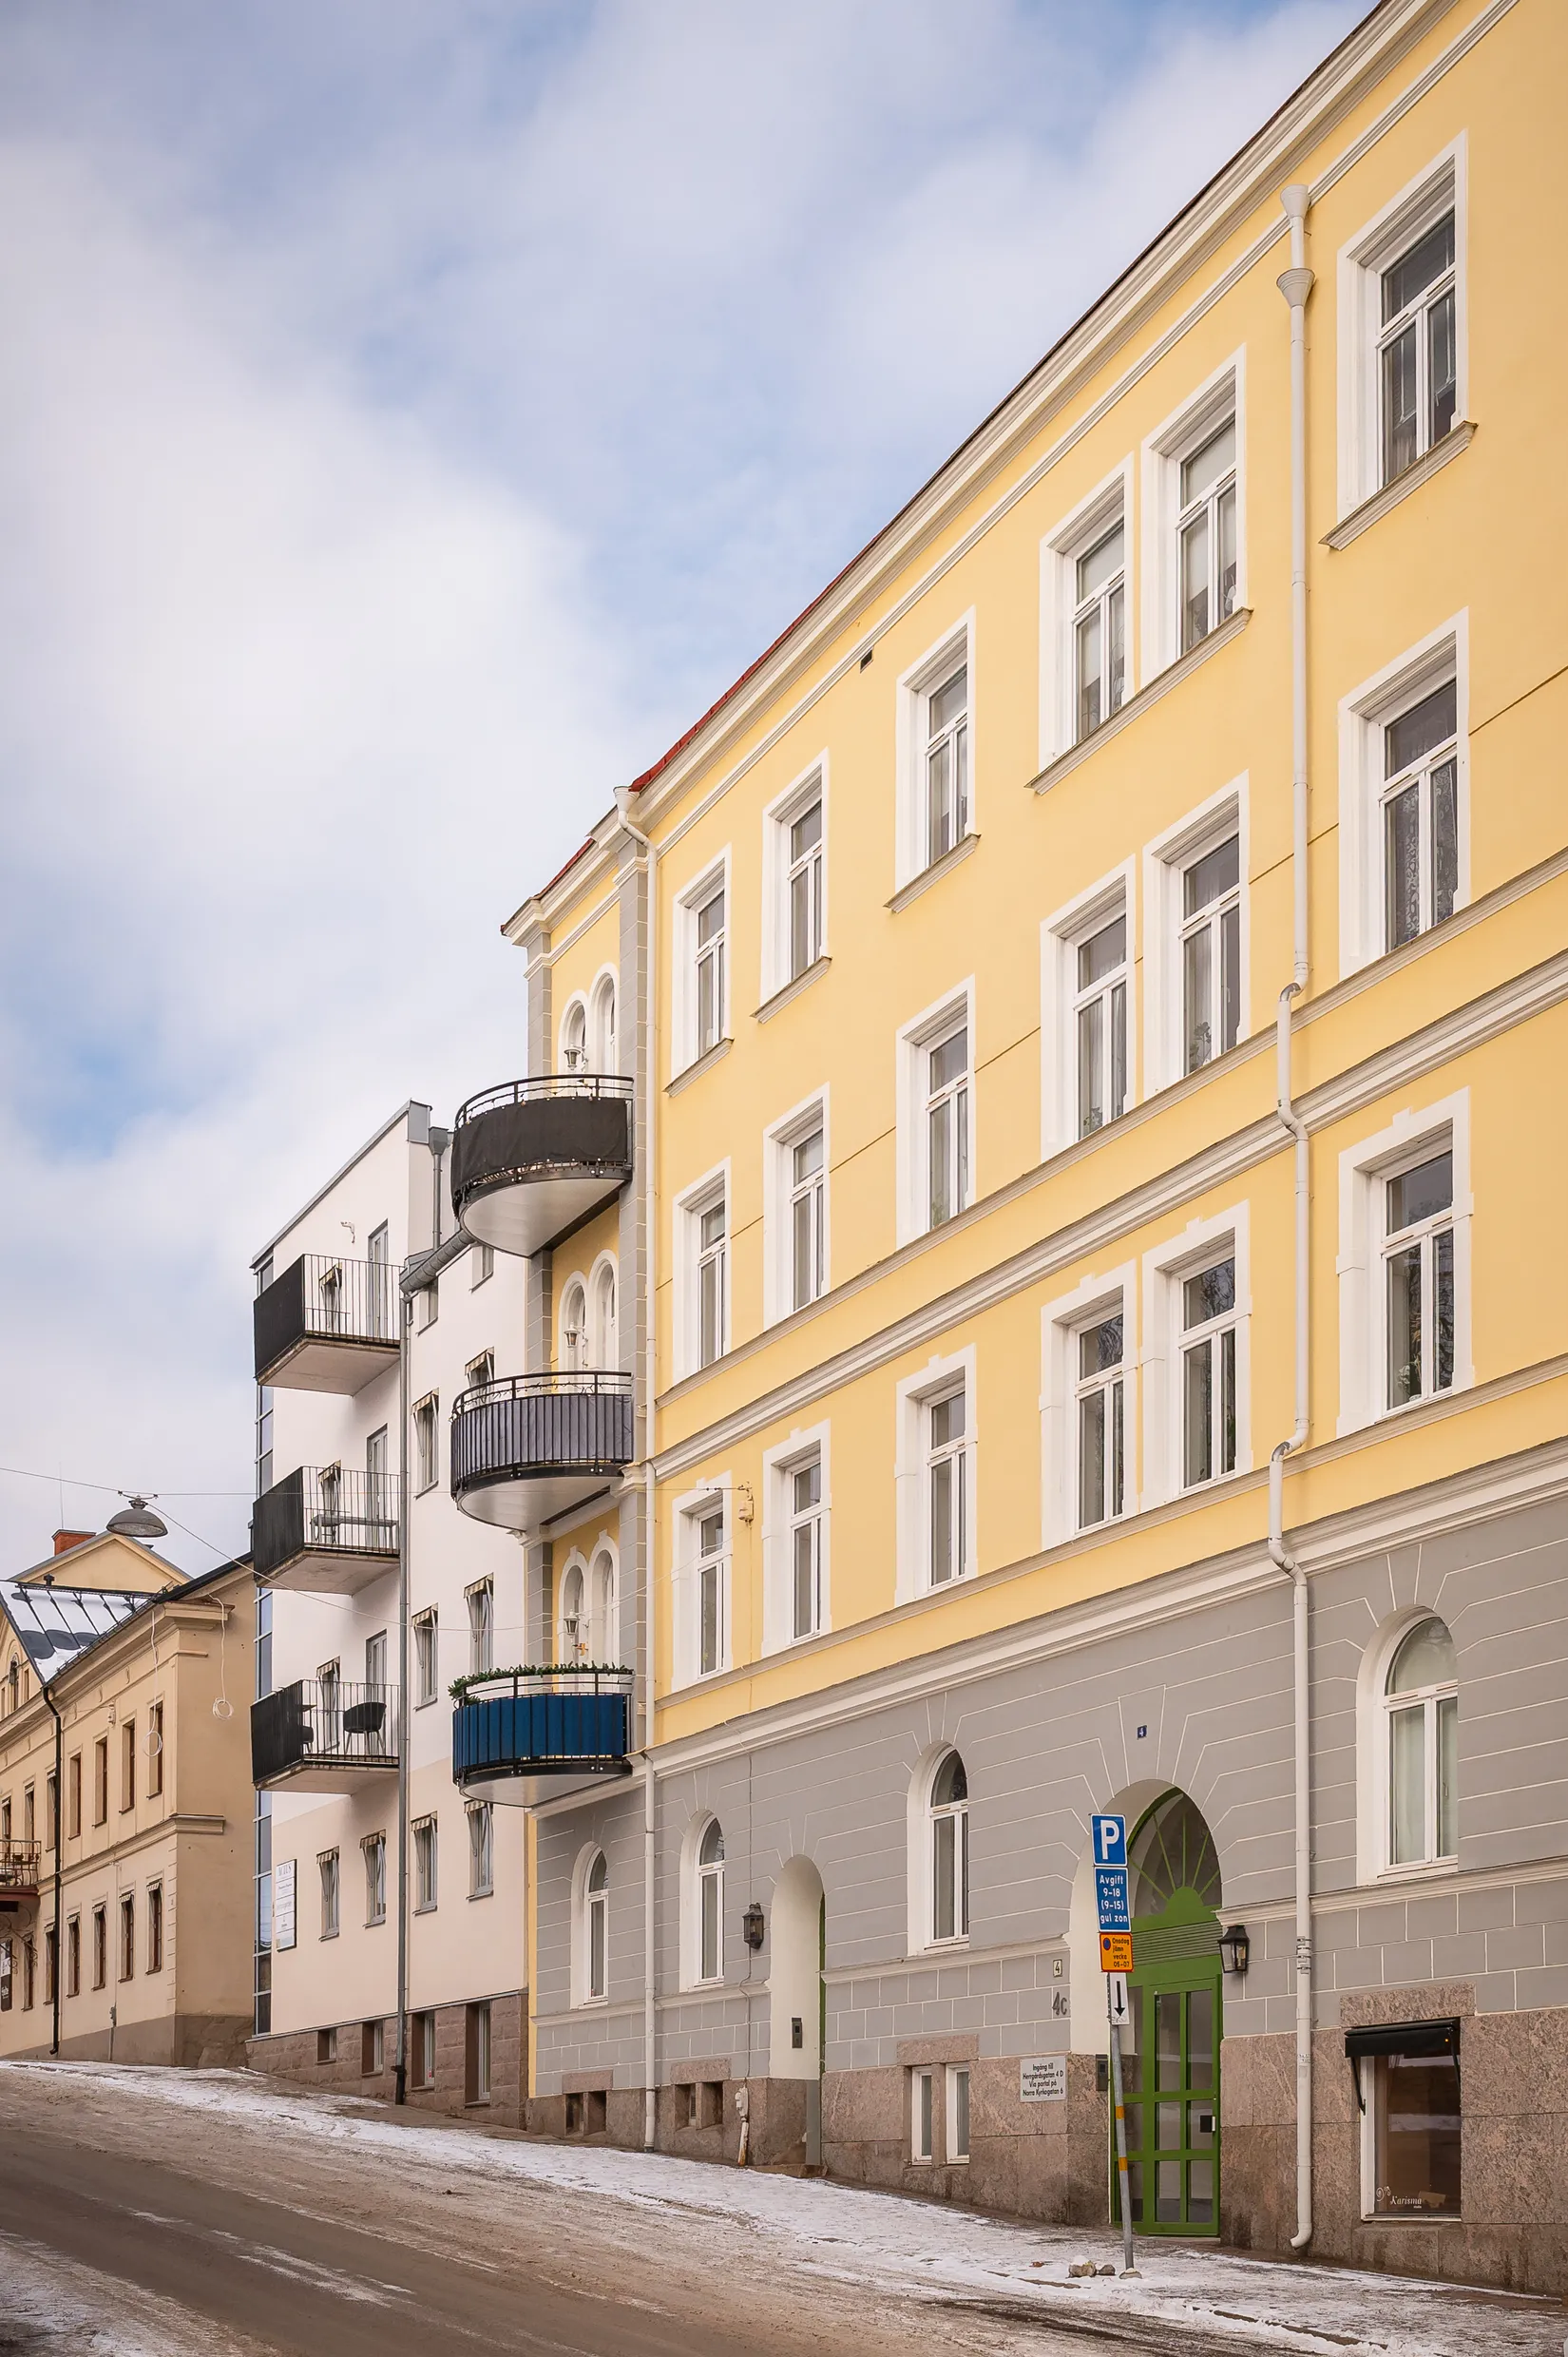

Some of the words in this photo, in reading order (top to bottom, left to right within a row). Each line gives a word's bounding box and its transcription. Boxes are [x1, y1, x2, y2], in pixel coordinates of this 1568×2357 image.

[1100, 1819, 1120, 1860] P
[1100, 1874, 1123, 1887] Avgift
[1102, 1888, 1120, 1897] 9-18
[1100, 1900, 1124, 1910] (9-15)
[1100, 1913, 1112, 1924] gul
[1114, 1914, 1128, 1923] zon
[1112, 1937, 1129, 1945] Onsdag
[1056, 1962, 1061, 1973] 4
[1033, 2063, 1047, 2072] Ingång
[1037, 2080, 1050, 2089] portal
[1050, 2079, 1057, 2088] på
[1036, 2088, 1060, 2097] Kyrkogatan
[1390, 2195, 1422, 2205] Karisma
